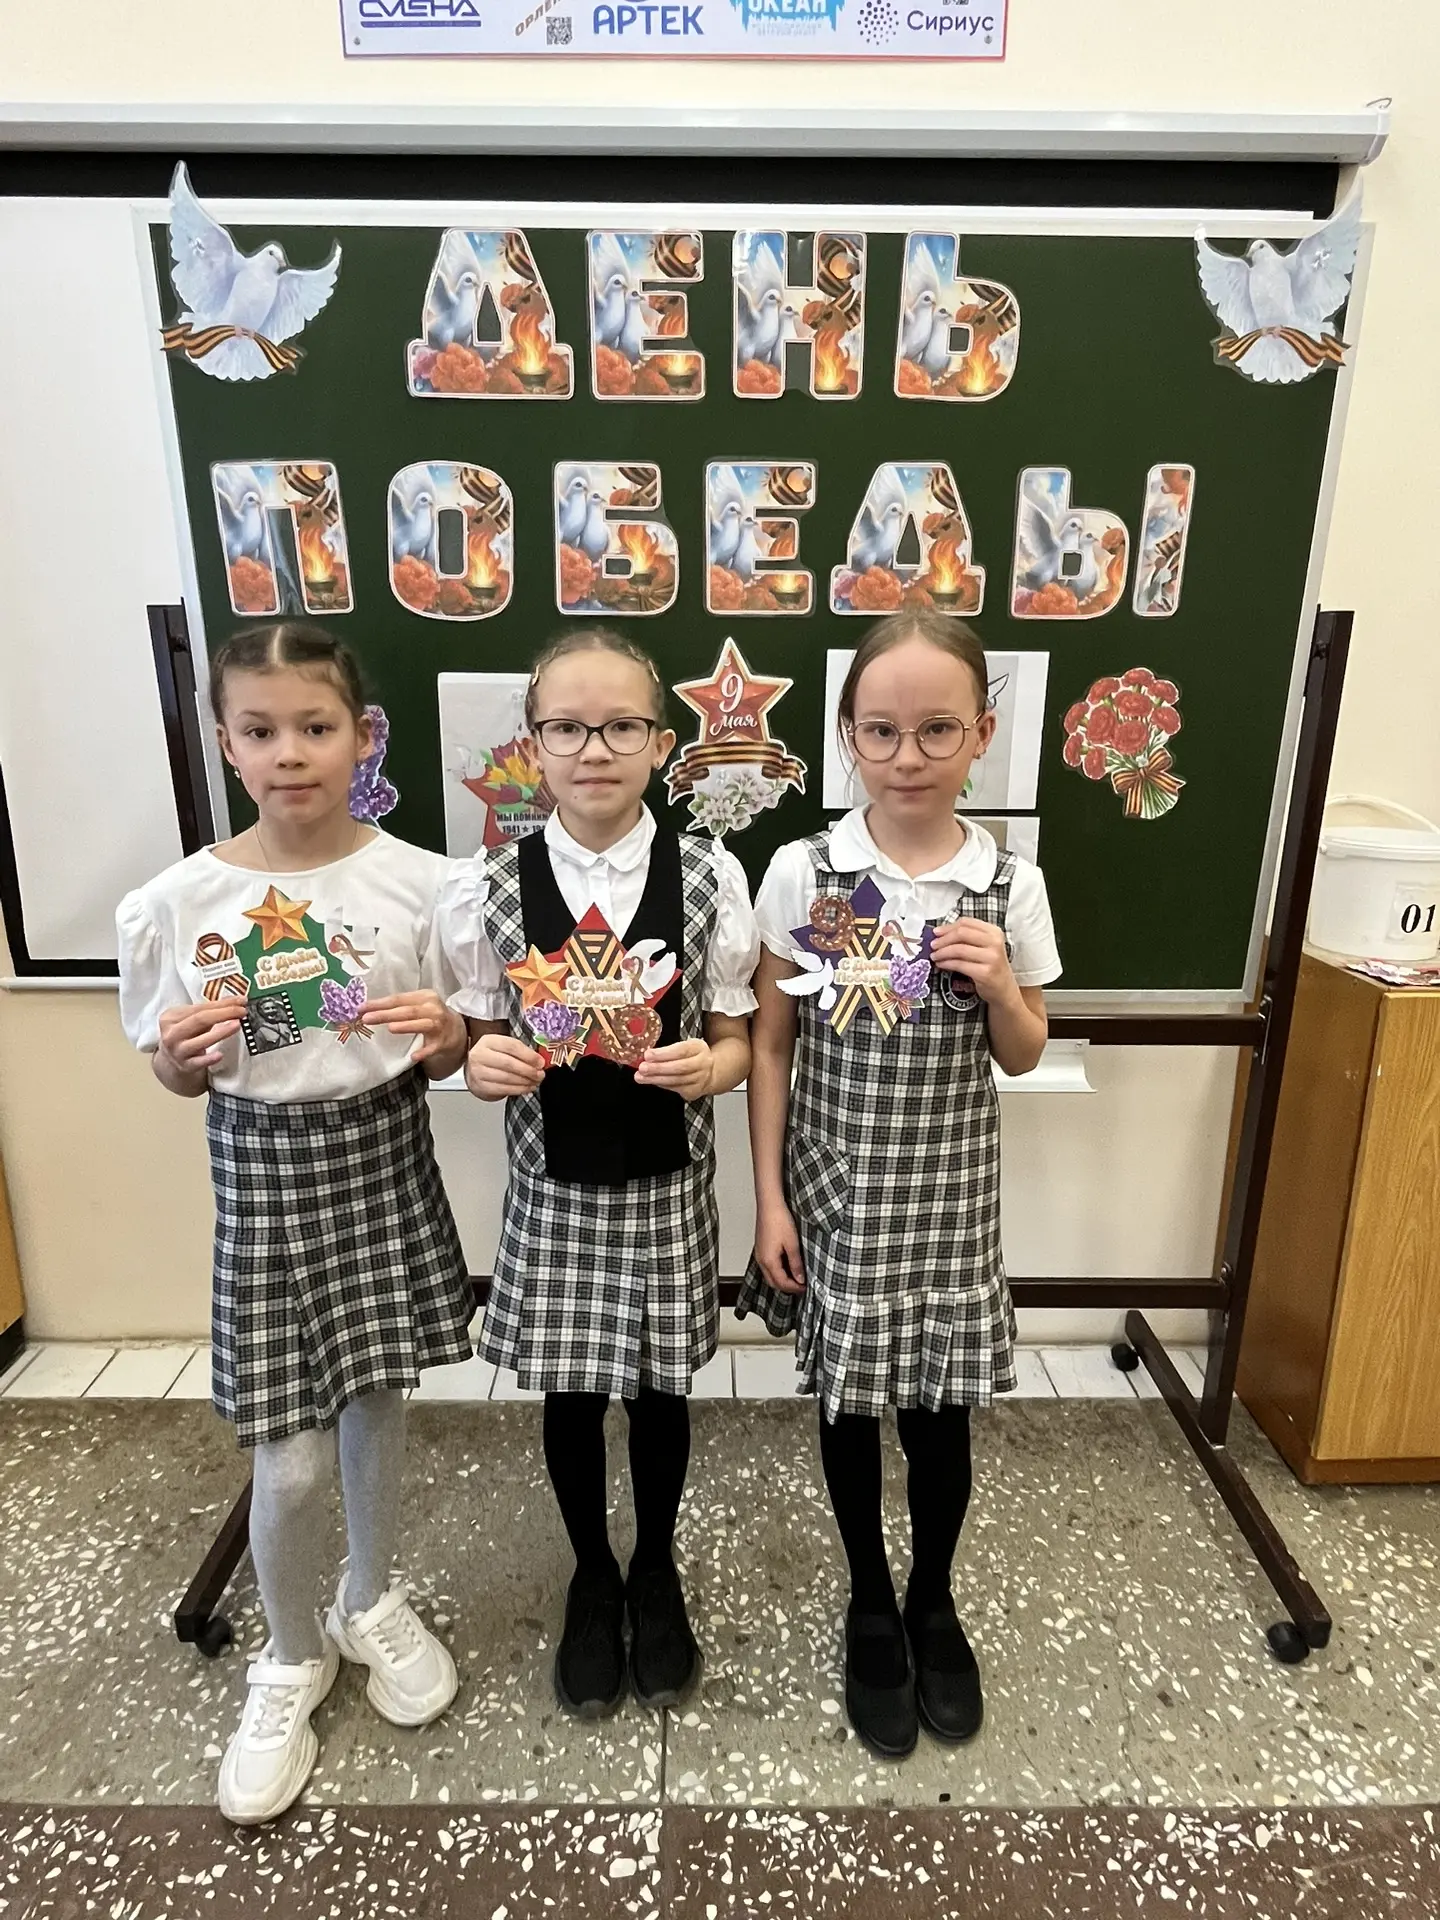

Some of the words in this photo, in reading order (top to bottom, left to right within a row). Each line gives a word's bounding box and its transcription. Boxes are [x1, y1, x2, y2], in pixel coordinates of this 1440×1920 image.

[593, 5, 705, 35] АРТЕК
[906, 10, 995, 36] Сириус
[407, 229, 1020, 400] ДЕНЬ
[211, 460, 1196, 620] ПОБЕДЫ
[718, 673, 744, 713] 9
[1401, 903, 1437, 934] 01
